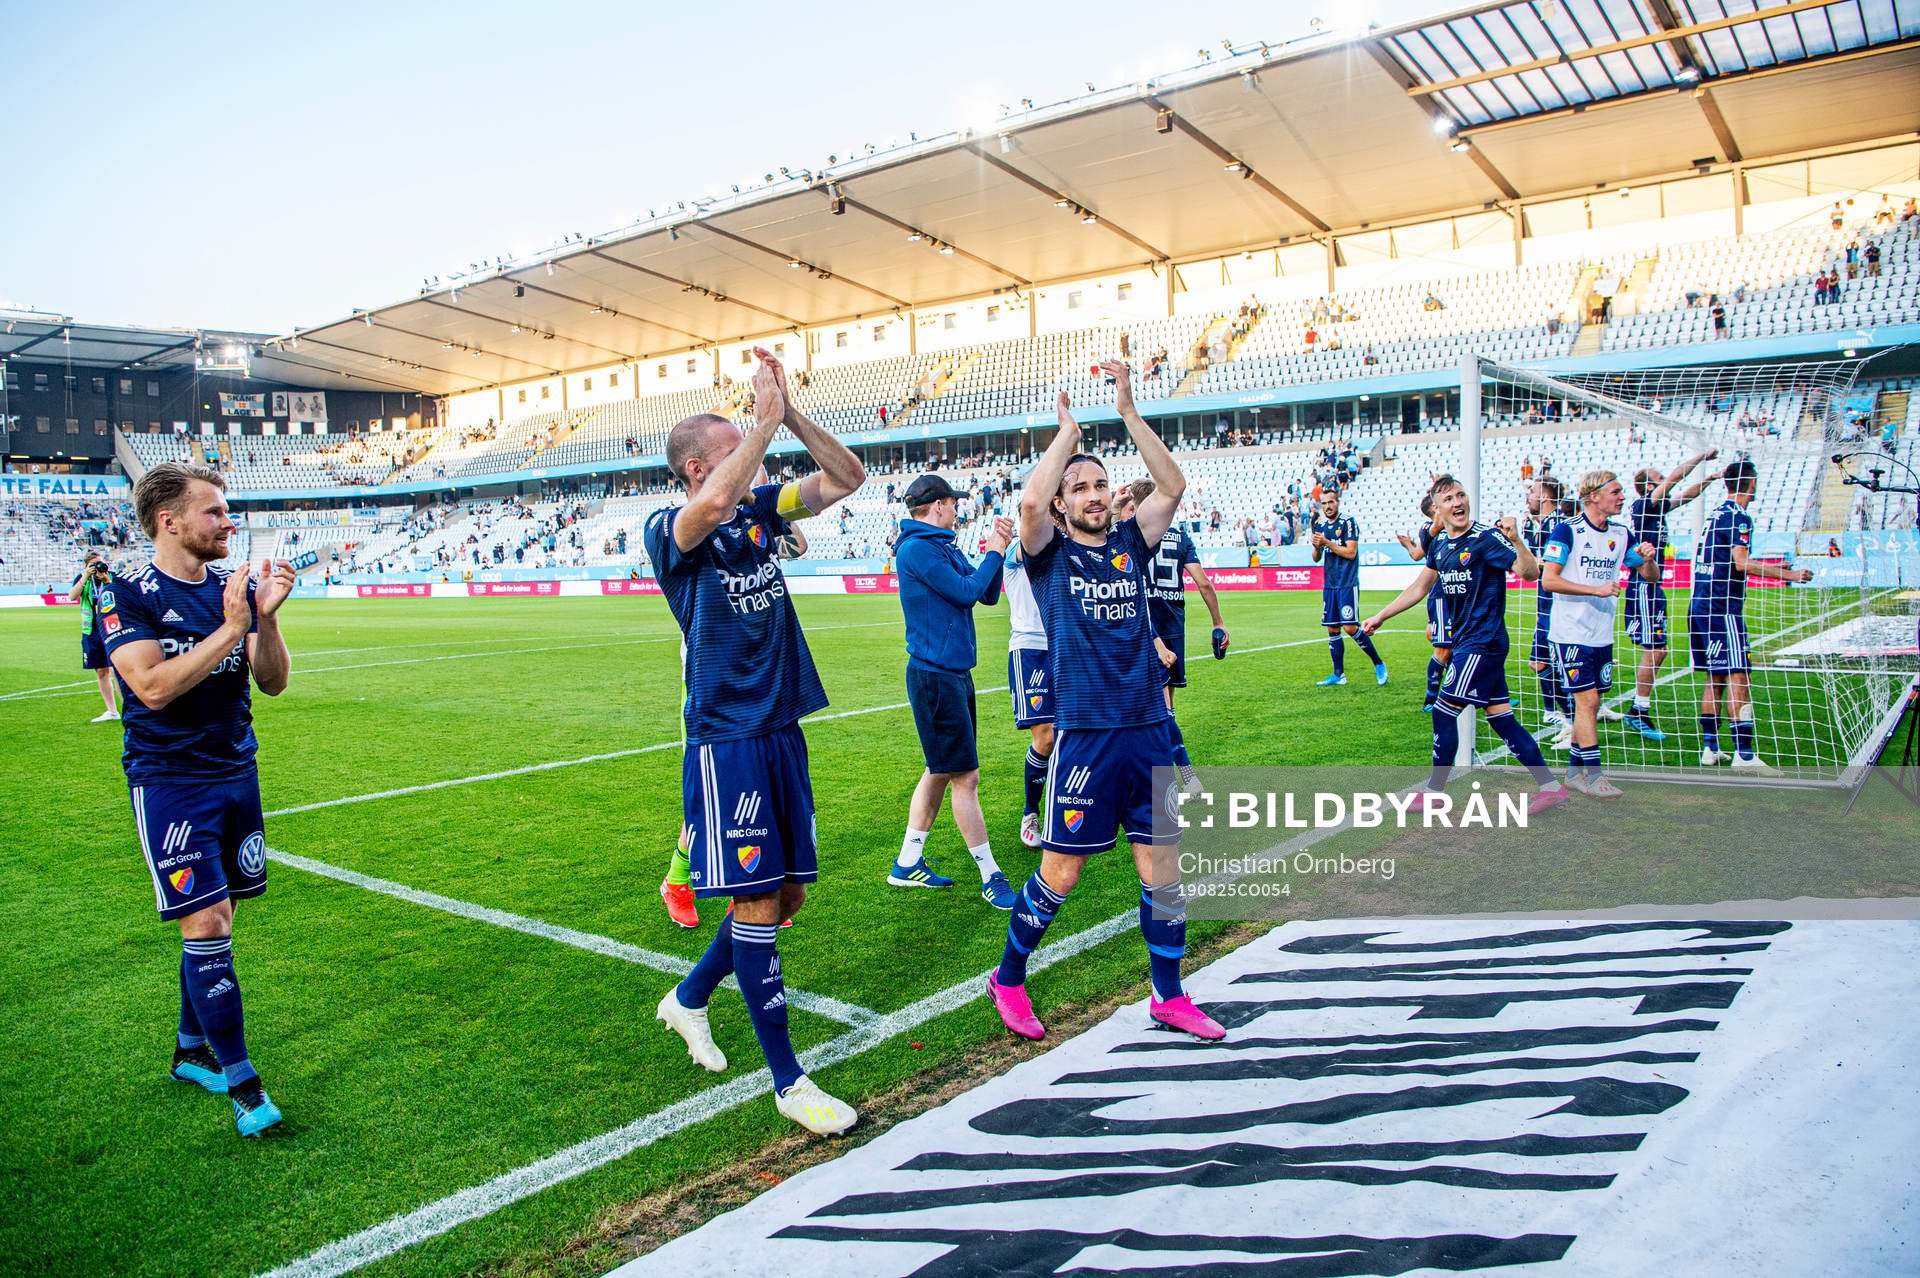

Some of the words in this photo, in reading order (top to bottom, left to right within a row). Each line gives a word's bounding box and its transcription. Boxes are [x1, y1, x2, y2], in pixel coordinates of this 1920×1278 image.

[38, 479, 109, 495] FALLA
[1580, 555, 1618, 569] Priorite
[854, 578, 877, 586] TICTAC
[1214, 573, 1257, 585] business
[1276, 570, 1311, 581] TICTAC
[1069, 576, 1138, 599] Priorite
[1080, 598, 1137, 620] Finans
[1057, 796, 1073, 804] NRC
[1072, 796, 1094, 807] Group
[726, 829, 745, 839] NRC
[745, 828, 768, 838] Group
[157, 858, 176, 870] NRC
[176, 851, 202, 864] Group
